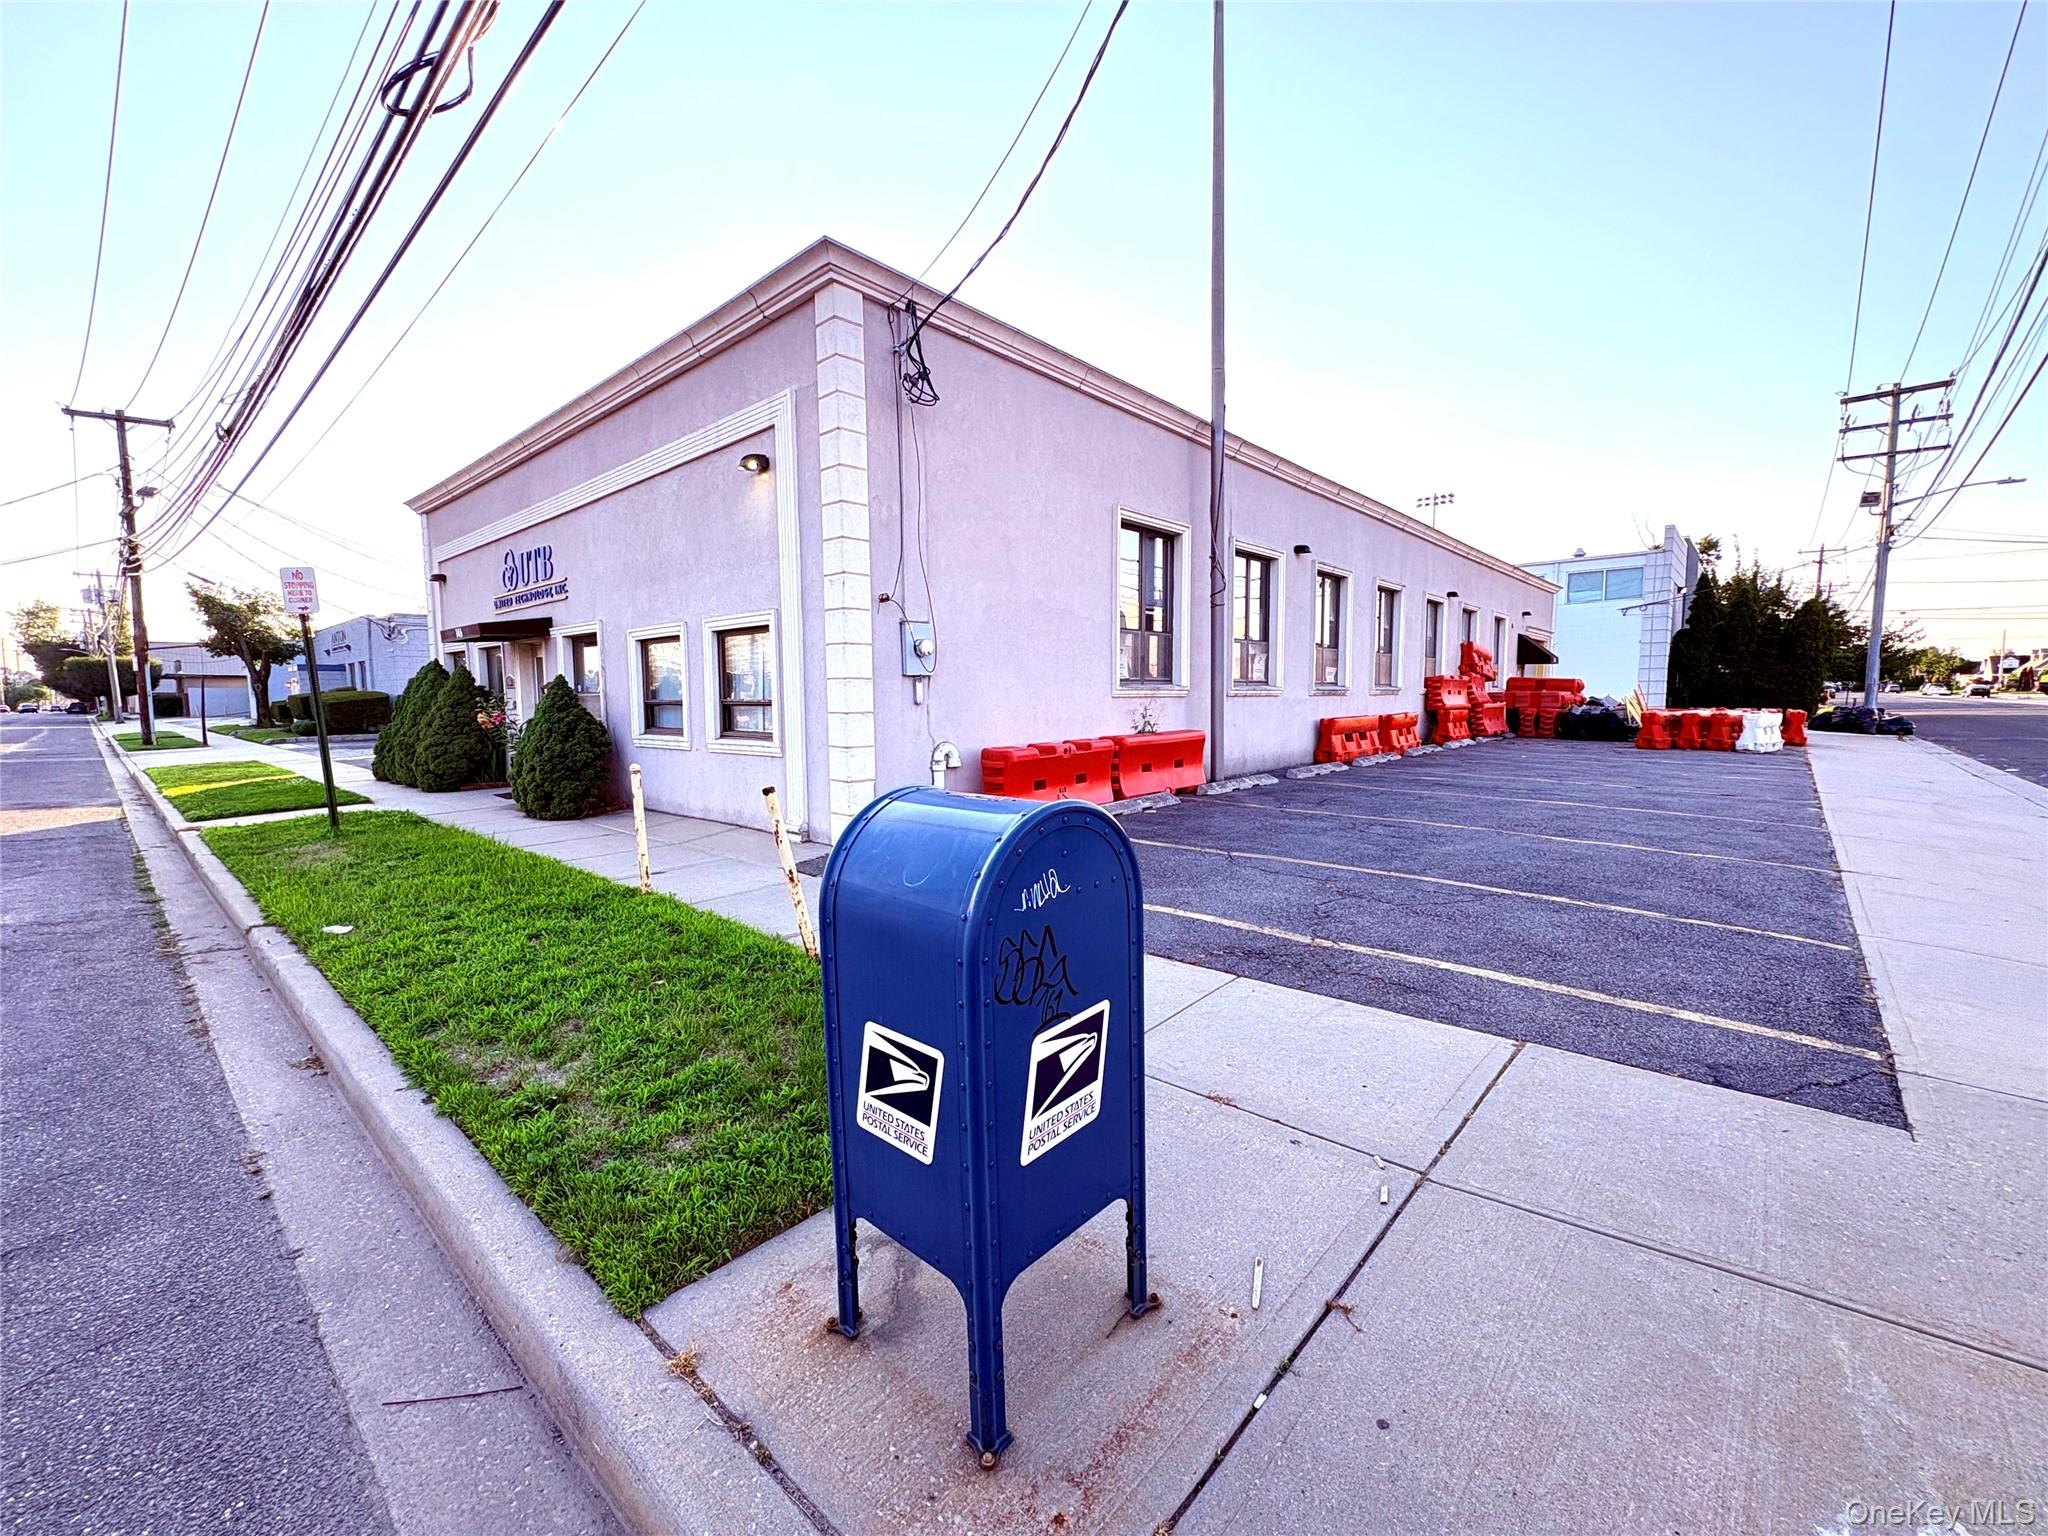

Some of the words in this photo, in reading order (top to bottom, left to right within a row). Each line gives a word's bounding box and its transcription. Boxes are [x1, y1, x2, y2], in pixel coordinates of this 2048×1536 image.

[291, 570, 304, 580] NO
[521, 545, 555, 586] UTB
[862, 1113, 892, 1137] POSTAL
[893, 1131, 928, 1157] SERVICE
[863, 1101, 894, 1124] UNITED
[895, 1118, 925, 1142] STATES
[1027, 1129, 1061, 1156] POSTAL
[1063, 1102, 1097, 1133] SERVICE
[1029, 1110, 1063, 1140] UNITED
[1064, 1091, 1094, 1118] STATES
